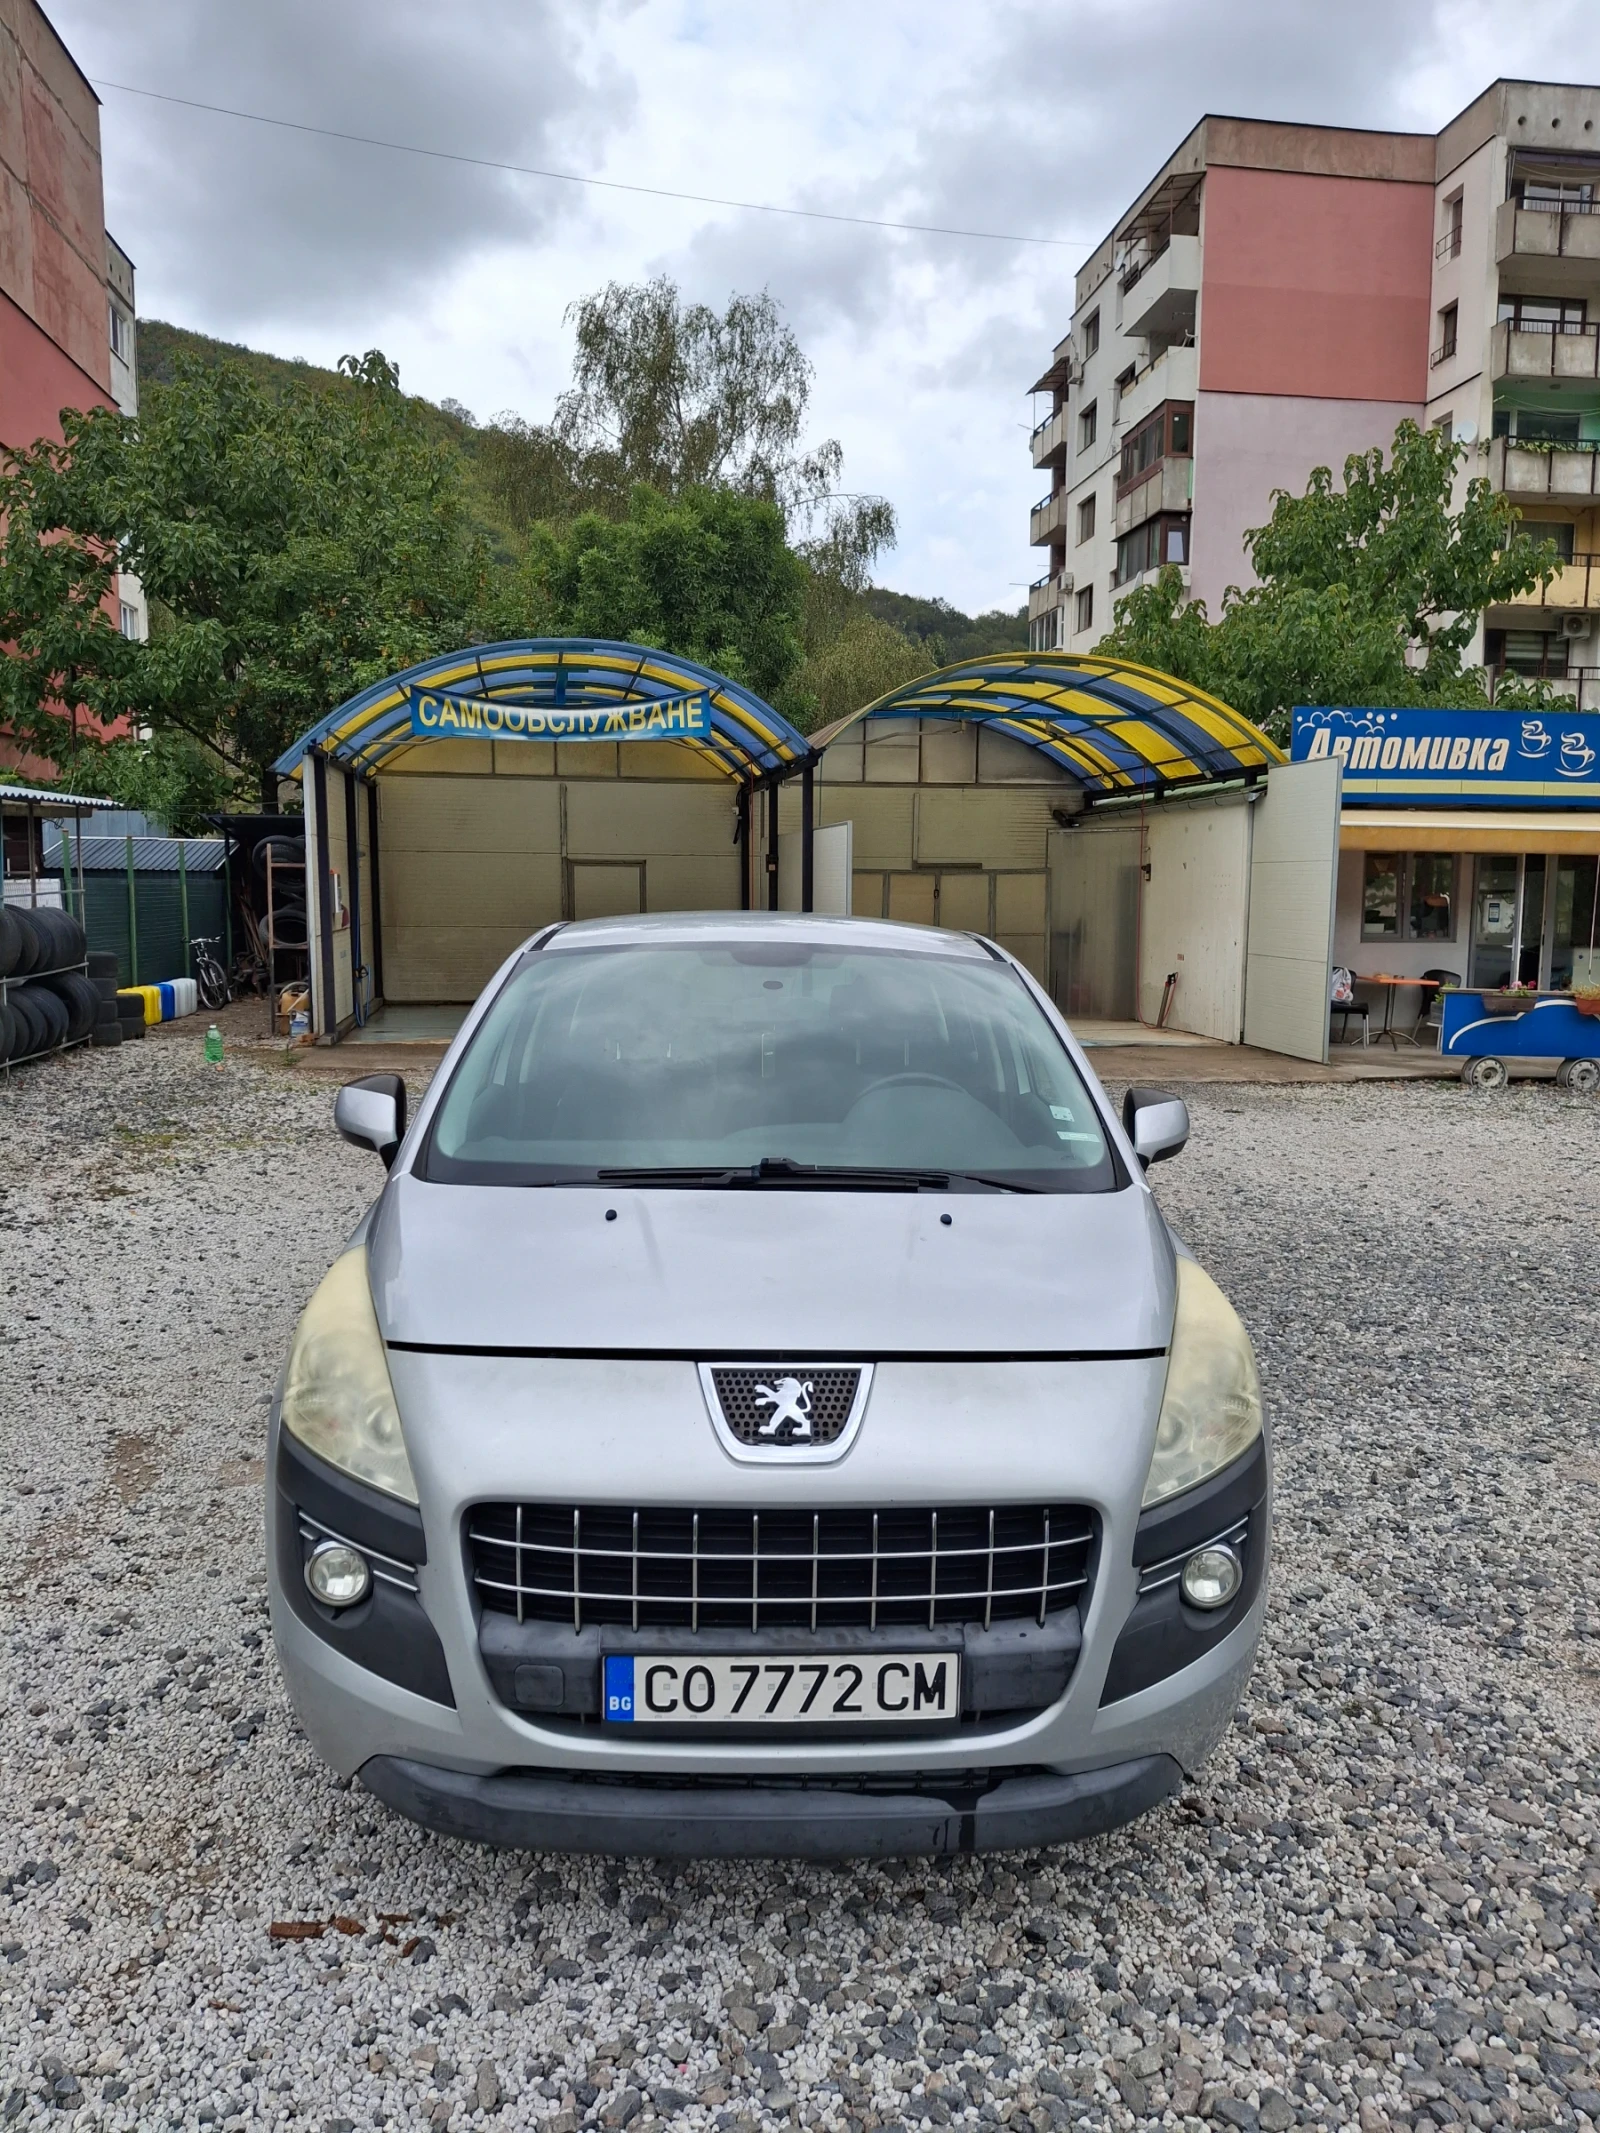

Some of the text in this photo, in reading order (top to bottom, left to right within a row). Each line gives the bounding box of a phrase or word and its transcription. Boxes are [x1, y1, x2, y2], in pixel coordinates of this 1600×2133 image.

[609, 1696, 632, 1711] BG
[645, 1661, 947, 1713] CO 7772 CM
